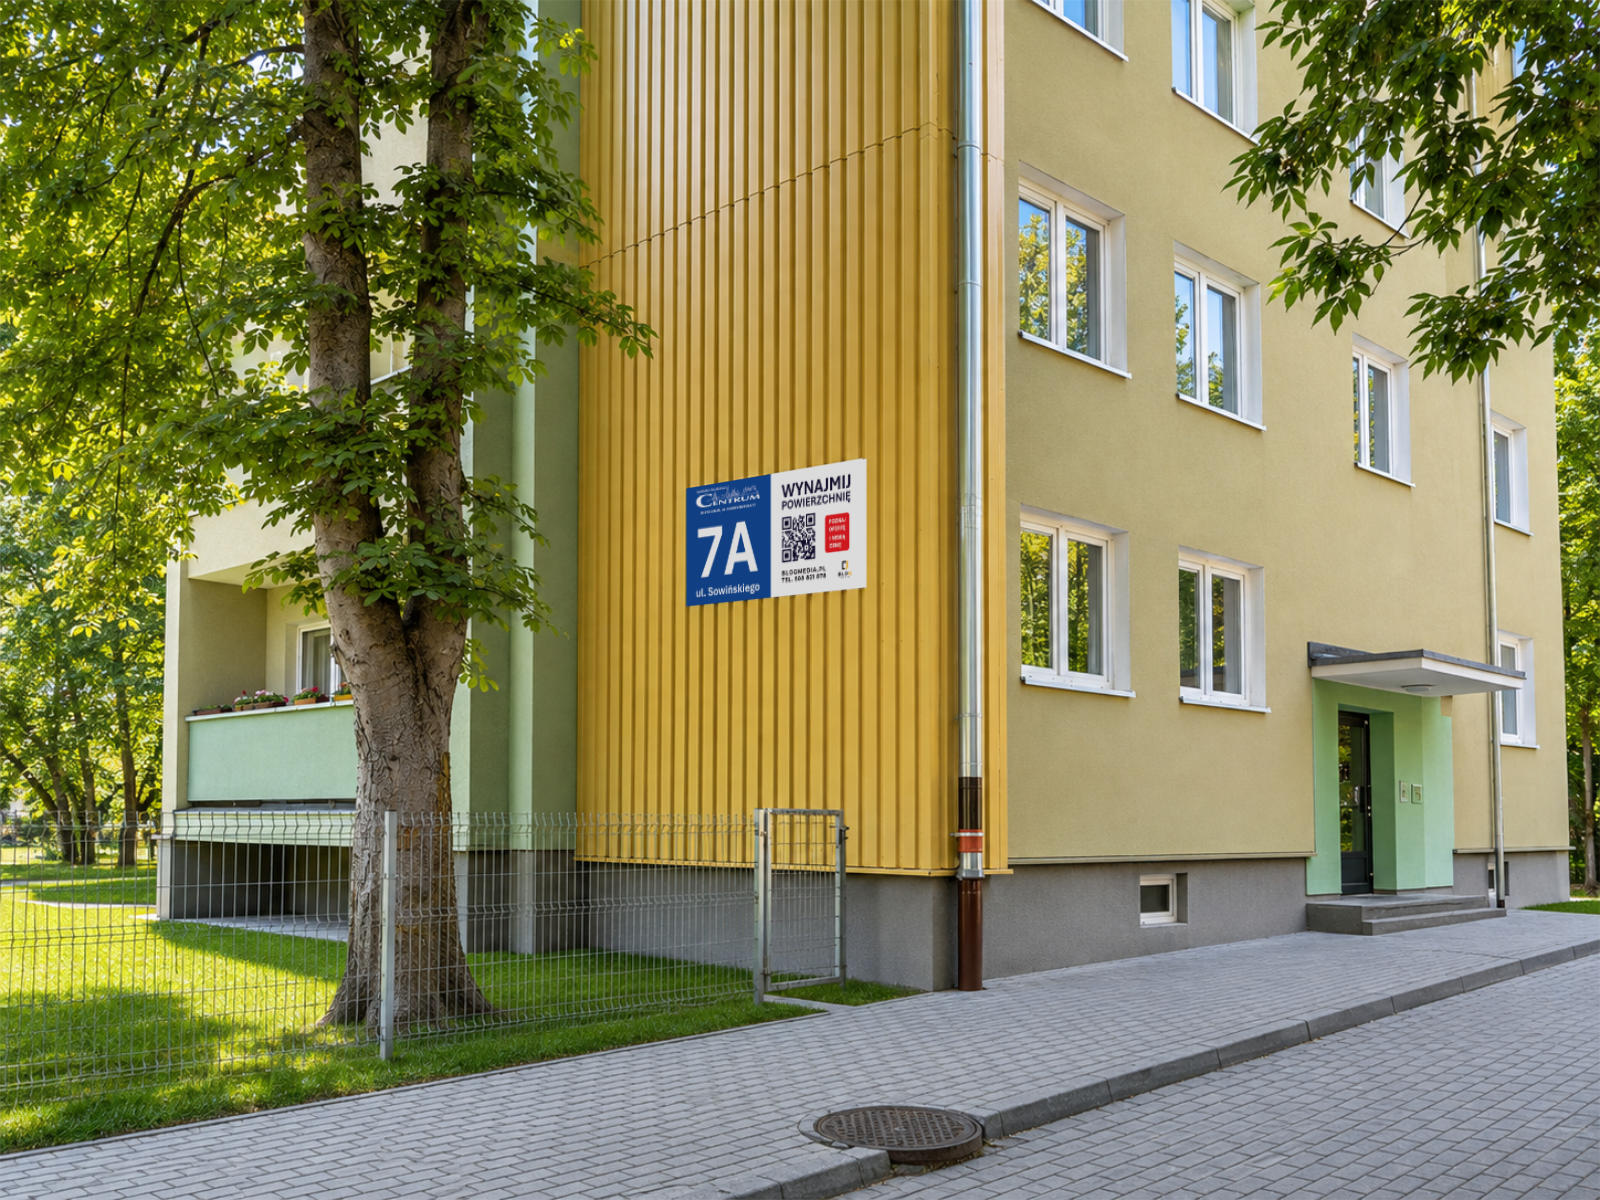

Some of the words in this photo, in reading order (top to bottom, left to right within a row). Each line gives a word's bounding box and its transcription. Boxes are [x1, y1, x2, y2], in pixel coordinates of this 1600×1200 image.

[781, 474, 851, 498] WYNAJMIJ
[695, 493, 761, 509] CENTRUM
[781, 490, 851, 511] POWIERZCHNIĘ
[697, 520, 758, 578] 7A
[695, 588, 706, 598] ul.
[708, 582, 761, 597] Sowińskiego
